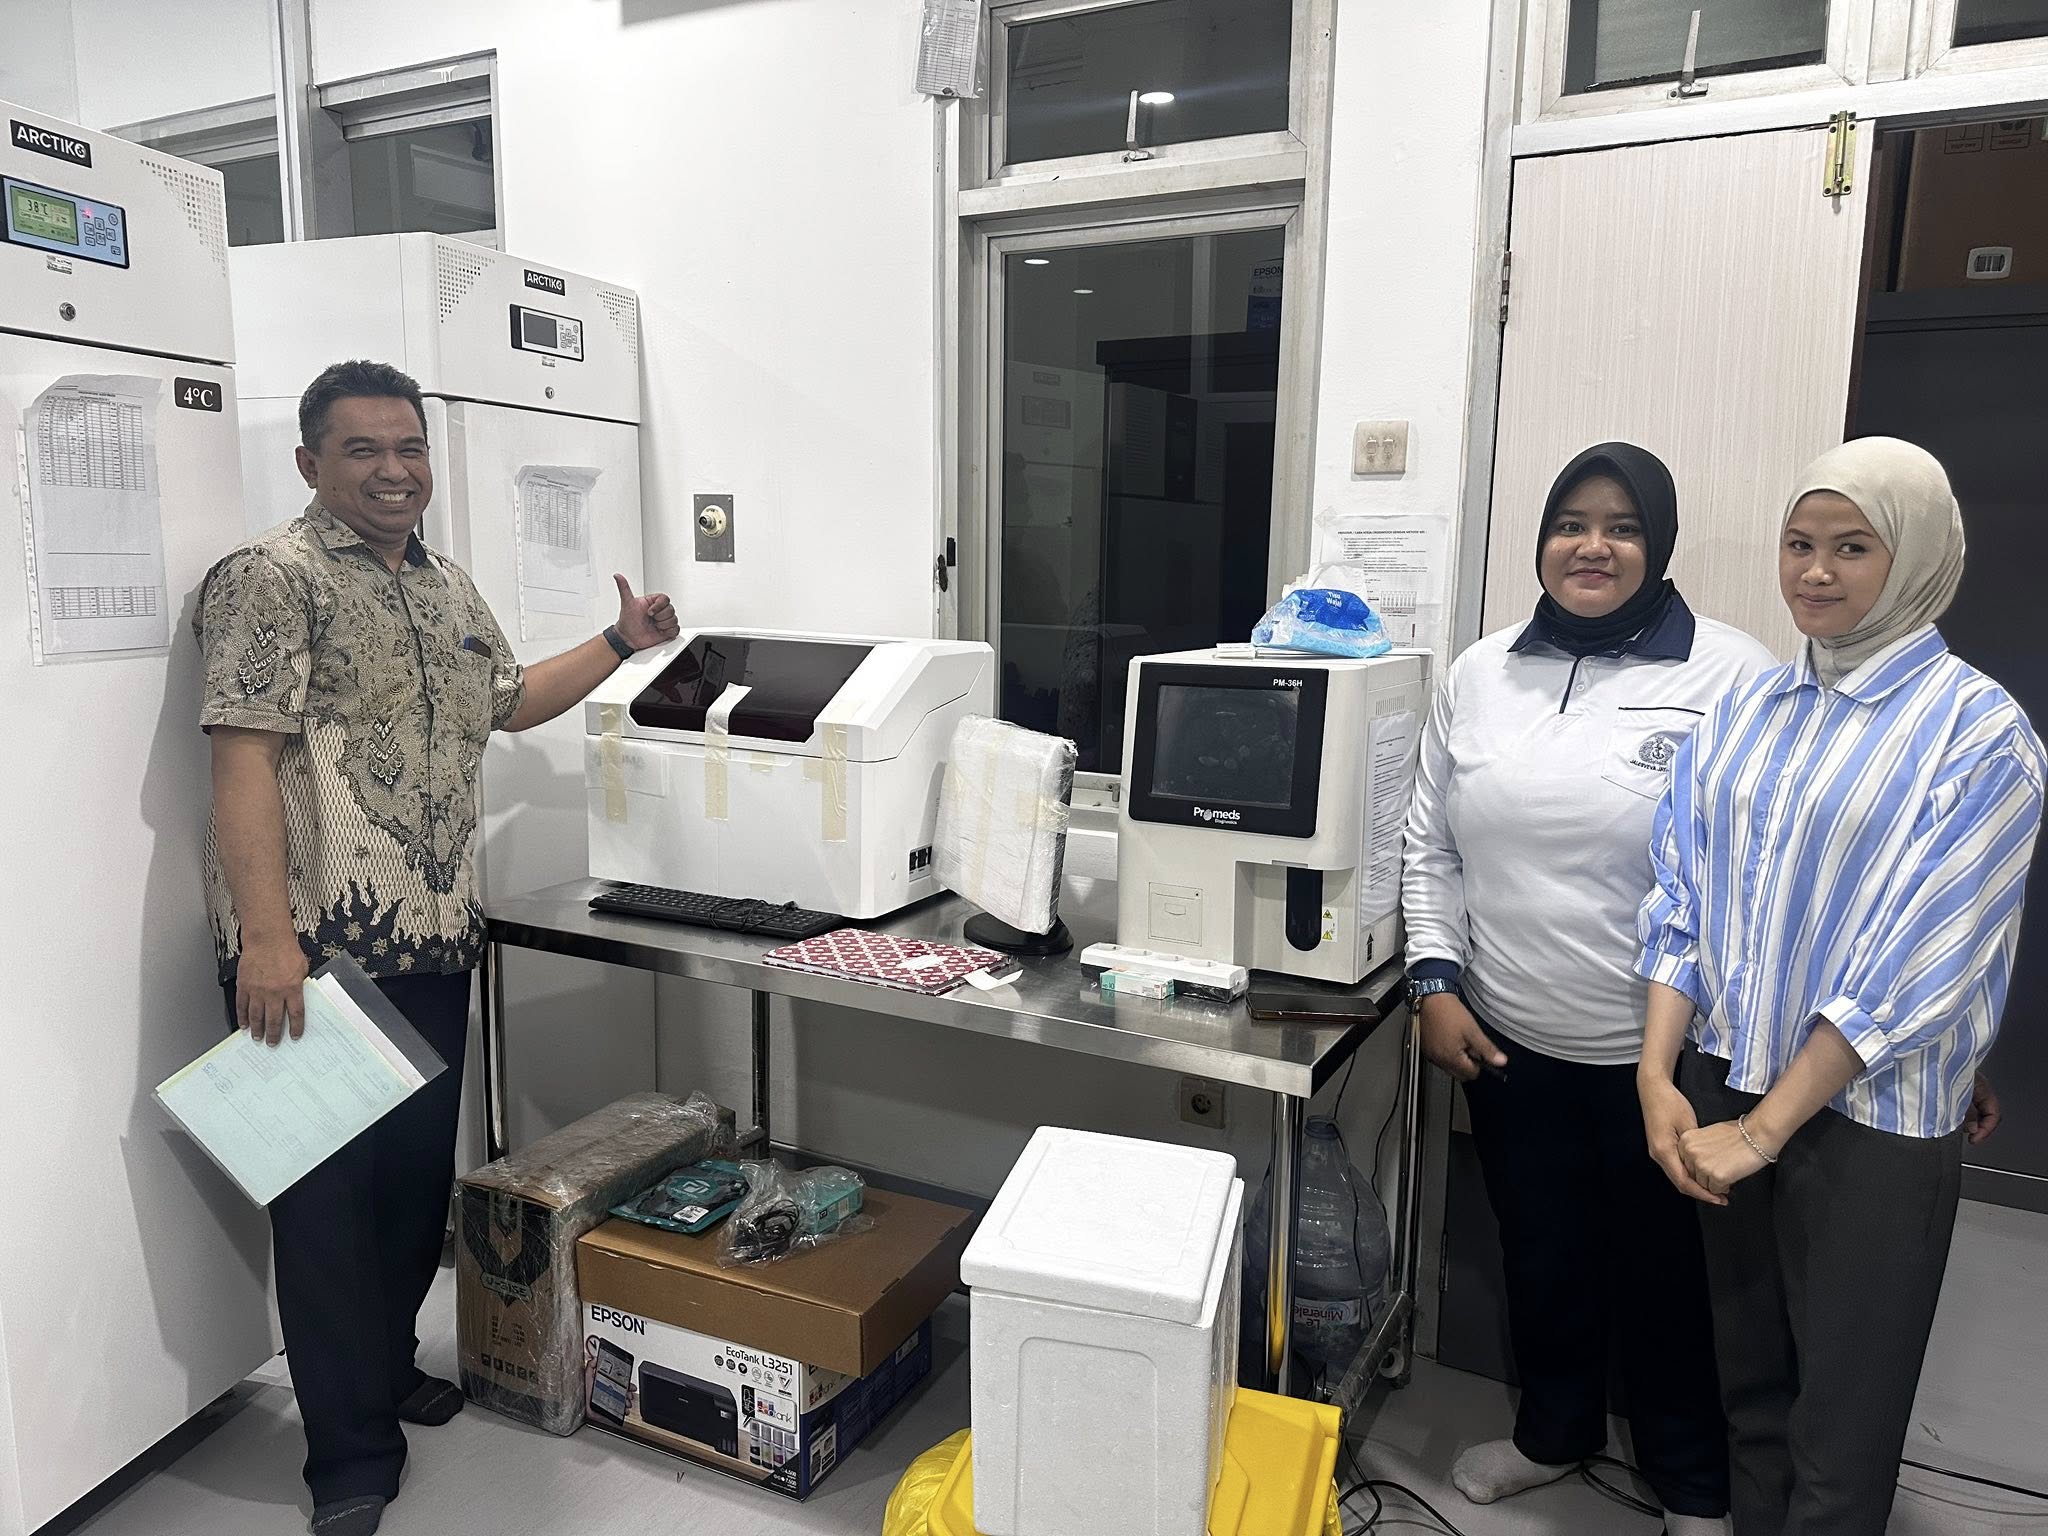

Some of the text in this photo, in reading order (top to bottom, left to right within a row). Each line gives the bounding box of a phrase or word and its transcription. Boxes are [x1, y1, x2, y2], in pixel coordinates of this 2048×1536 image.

[16, 125, 86, 159] ARCTIKO
[526, 272, 563, 291] ARCTIKO
[183, 386, 214, 408] 4°C
[1273, 678, 1303, 687] PM-36H
[591, 1304, 645, 1336] EPSON
[725, 1346, 760, 1365] EcoTank
[762, 1355, 793, 1376] L3251
